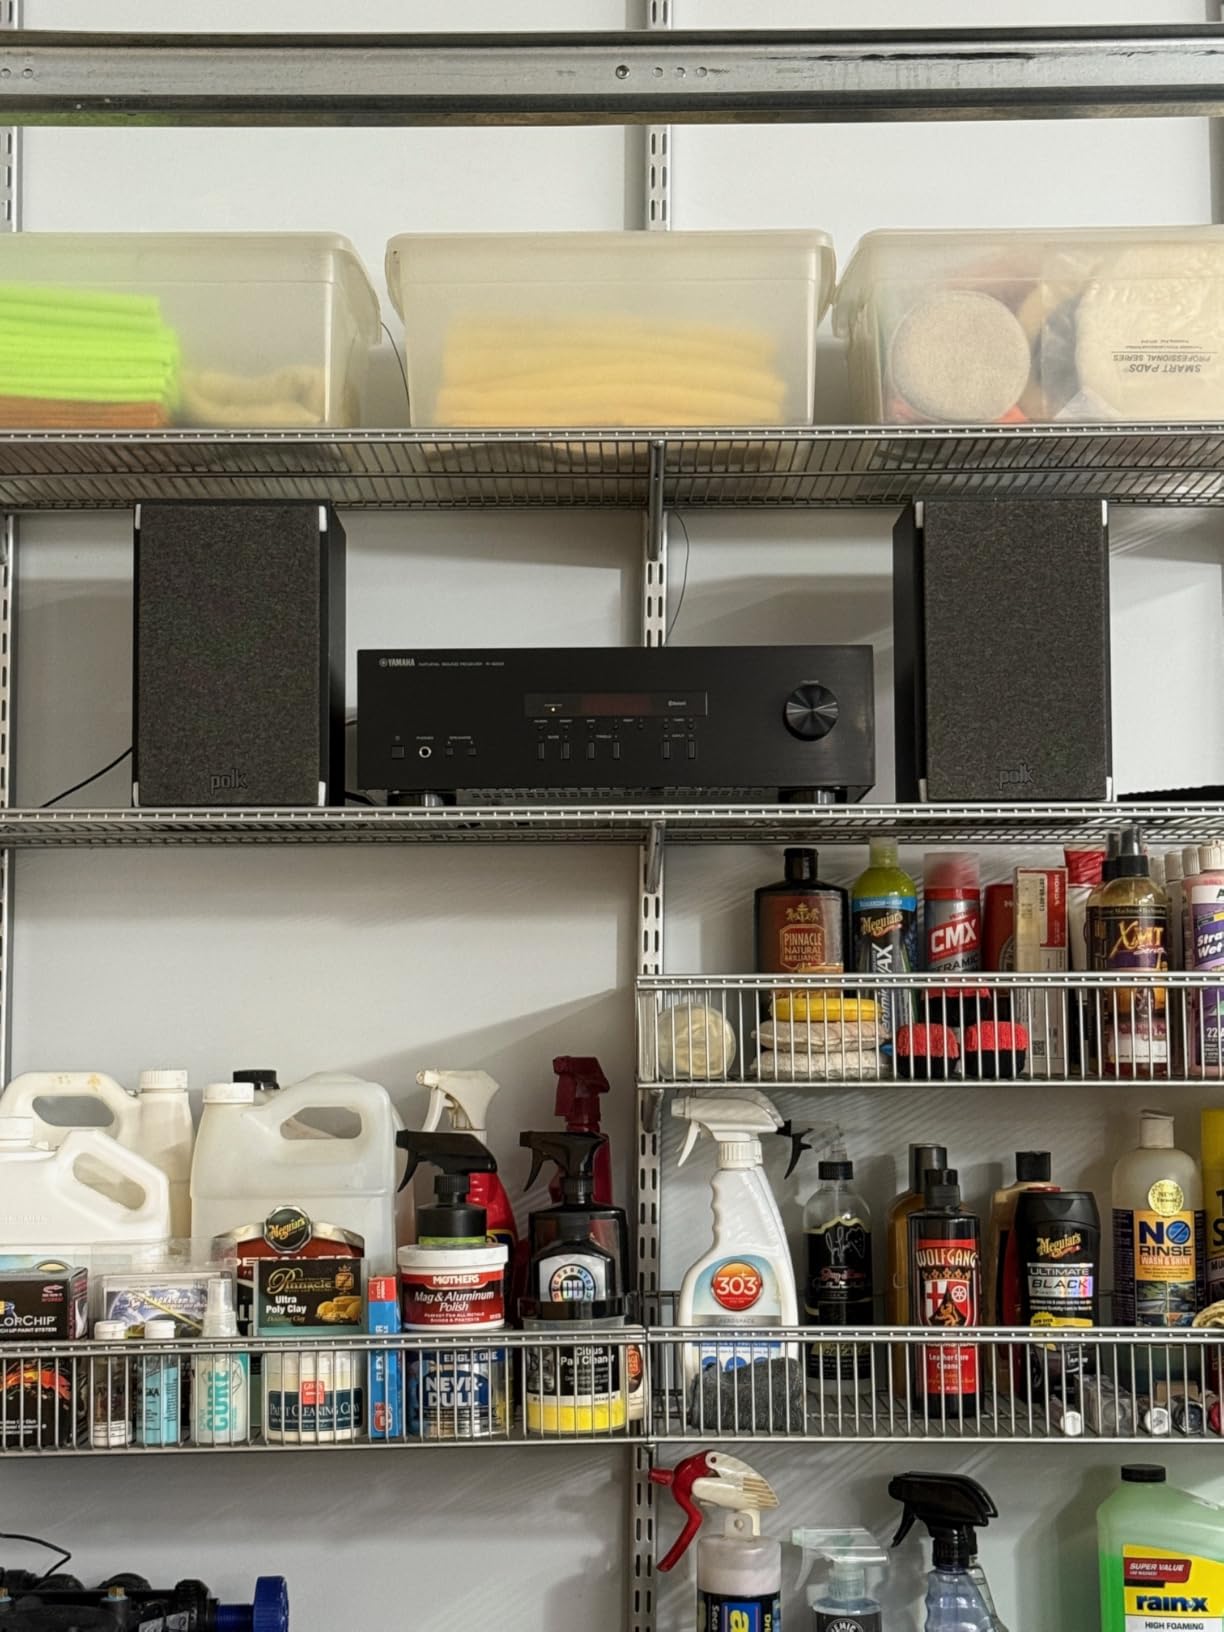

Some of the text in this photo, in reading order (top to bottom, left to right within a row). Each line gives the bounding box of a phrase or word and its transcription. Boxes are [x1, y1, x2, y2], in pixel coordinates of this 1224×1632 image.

[1113, 354, 1212, 362] PROFESSIONAL SERIES
[1128, 363, 1202, 374] SMART PADS
[387, 658, 416, 667] YAMAHA
[210, 767, 249, 796] polk
[999, 762, 1034, 790] polk
[784, 933, 822, 946] PINNACLE
[930, 919, 977, 953] CMX
[784, 946, 822, 954] NATURAL
[1198, 945, 1222, 959] Wet
[1138, 1220, 1191, 1245] NO
[1036, 1233, 1081, 1260] Meguiar's
[1140, 1246, 1192, 1256] RINSE
[915, 1248, 977, 1268] WOLFGANG
[1142, 1257, 1161, 1265] WASH
[1030, 1267, 1089, 1276] ULTIMATE
[433, 1274, 480, 1285] MOTHERS
[717, 1276, 757, 1295] 303
[1031, 1279, 1088, 1289] BLACK
[275, 1295, 298, 1304] Ultra
[414, 1290, 495, 1304] Mag & Aluminum
[265, 1304, 285, 1315] Poly
[287, 1303, 307, 1315] Clay
[439, 1301, 469, 1312] Polish
[375, 1356, 384, 1382] FLEX
[206, 1371, 229, 1433] CURE
[428, 1392, 479, 1407] DULL
[1145, 1621, 1204, 1630] HIGH FOAMING
